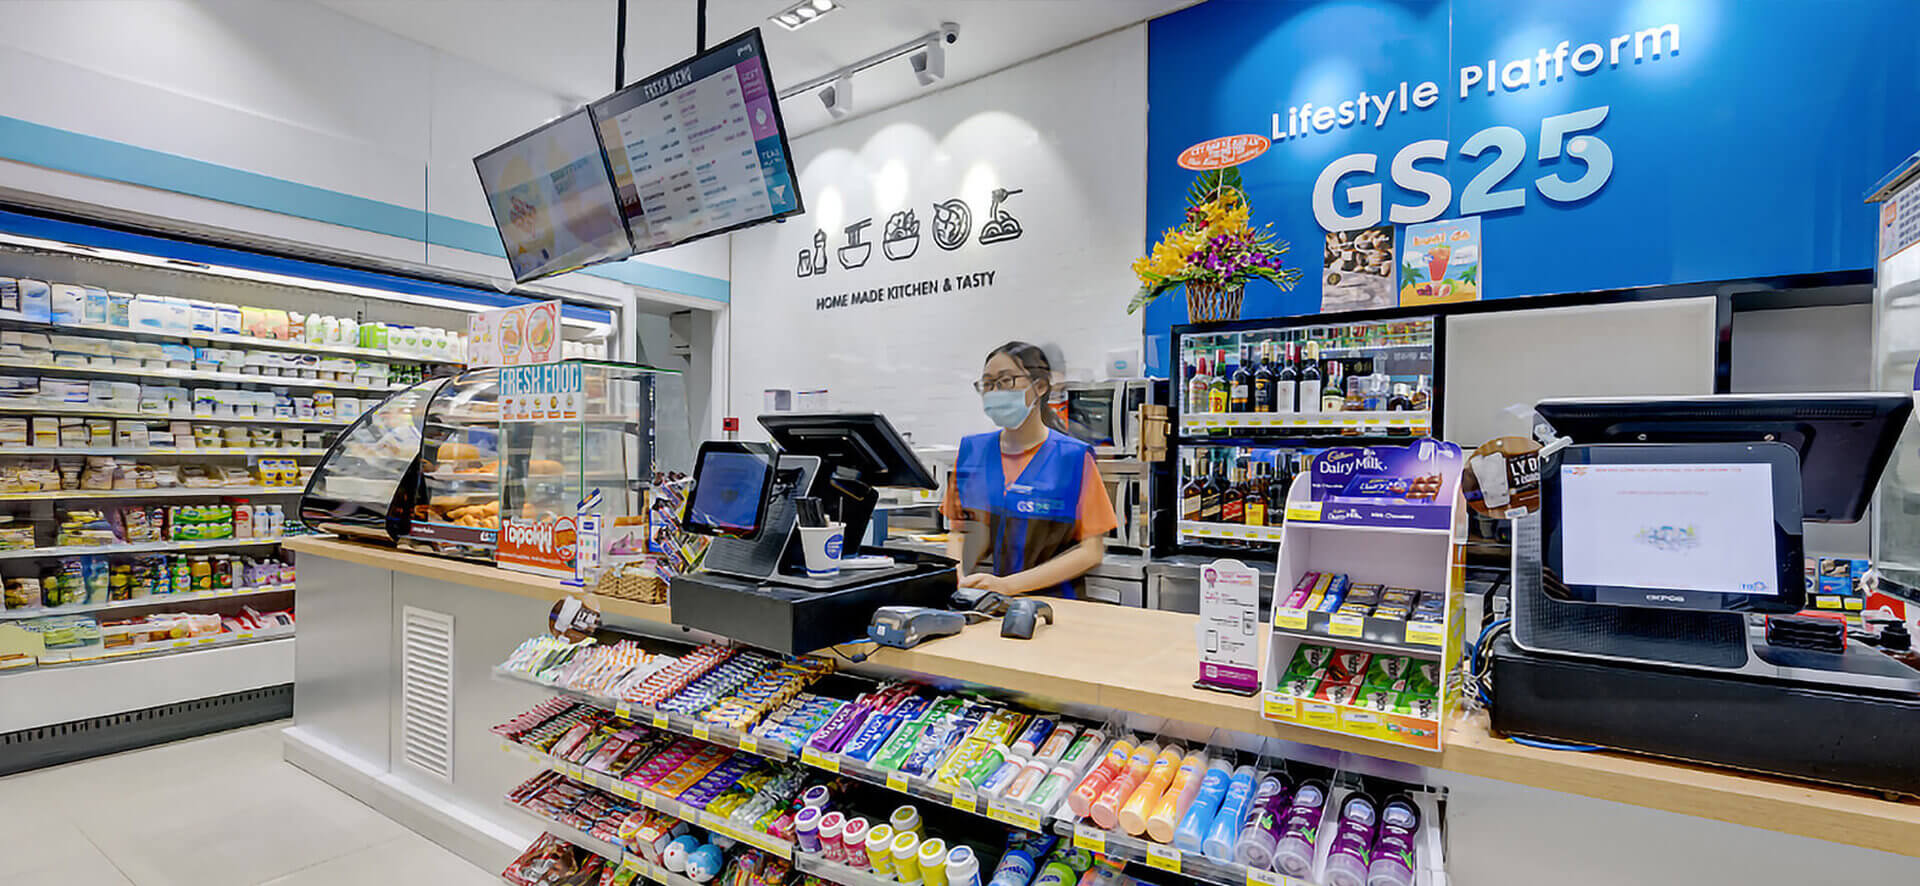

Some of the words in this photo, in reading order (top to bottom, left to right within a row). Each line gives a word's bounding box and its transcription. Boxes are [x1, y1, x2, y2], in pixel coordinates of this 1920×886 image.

[1271, 81, 1439, 141] Lifestyle
[1460, 23, 1680, 99] Platform
[1312, 105, 1613, 233] GS25
[816, 293, 848, 310] HOME
[851, 287, 884, 305] MADE
[887, 280, 938, 300] KITCHEN
[943, 278, 952, 292] &
[956, 270, 996, 290] TASTY
[501, 366, 541, 394] FRESH
[544, 364, 579, 393] FOOD
[1320, 460, 1355, 475] Dairy
